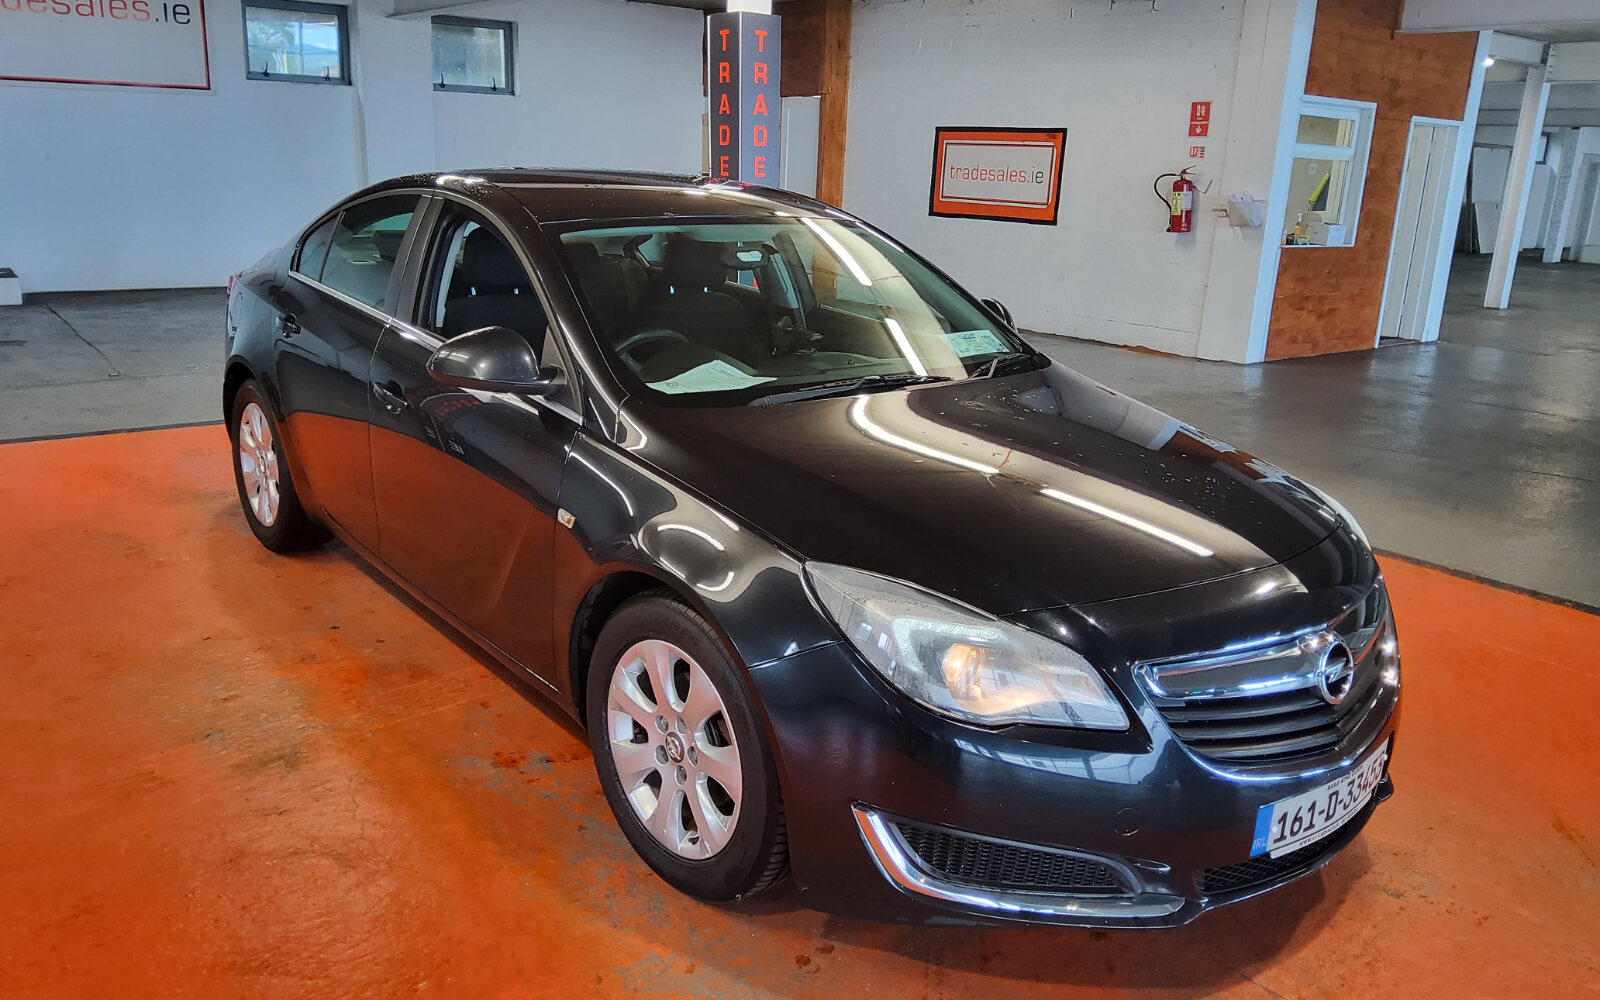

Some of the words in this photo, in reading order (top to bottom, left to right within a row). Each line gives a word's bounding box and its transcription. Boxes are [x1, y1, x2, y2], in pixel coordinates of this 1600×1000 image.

[718, 29, 731, 177] TRADE
[752, 29, 768, 178] TRADE
[949, 164, 1044, 184] tradesales.ie
[1252, 837, 1267, 850] IRL
